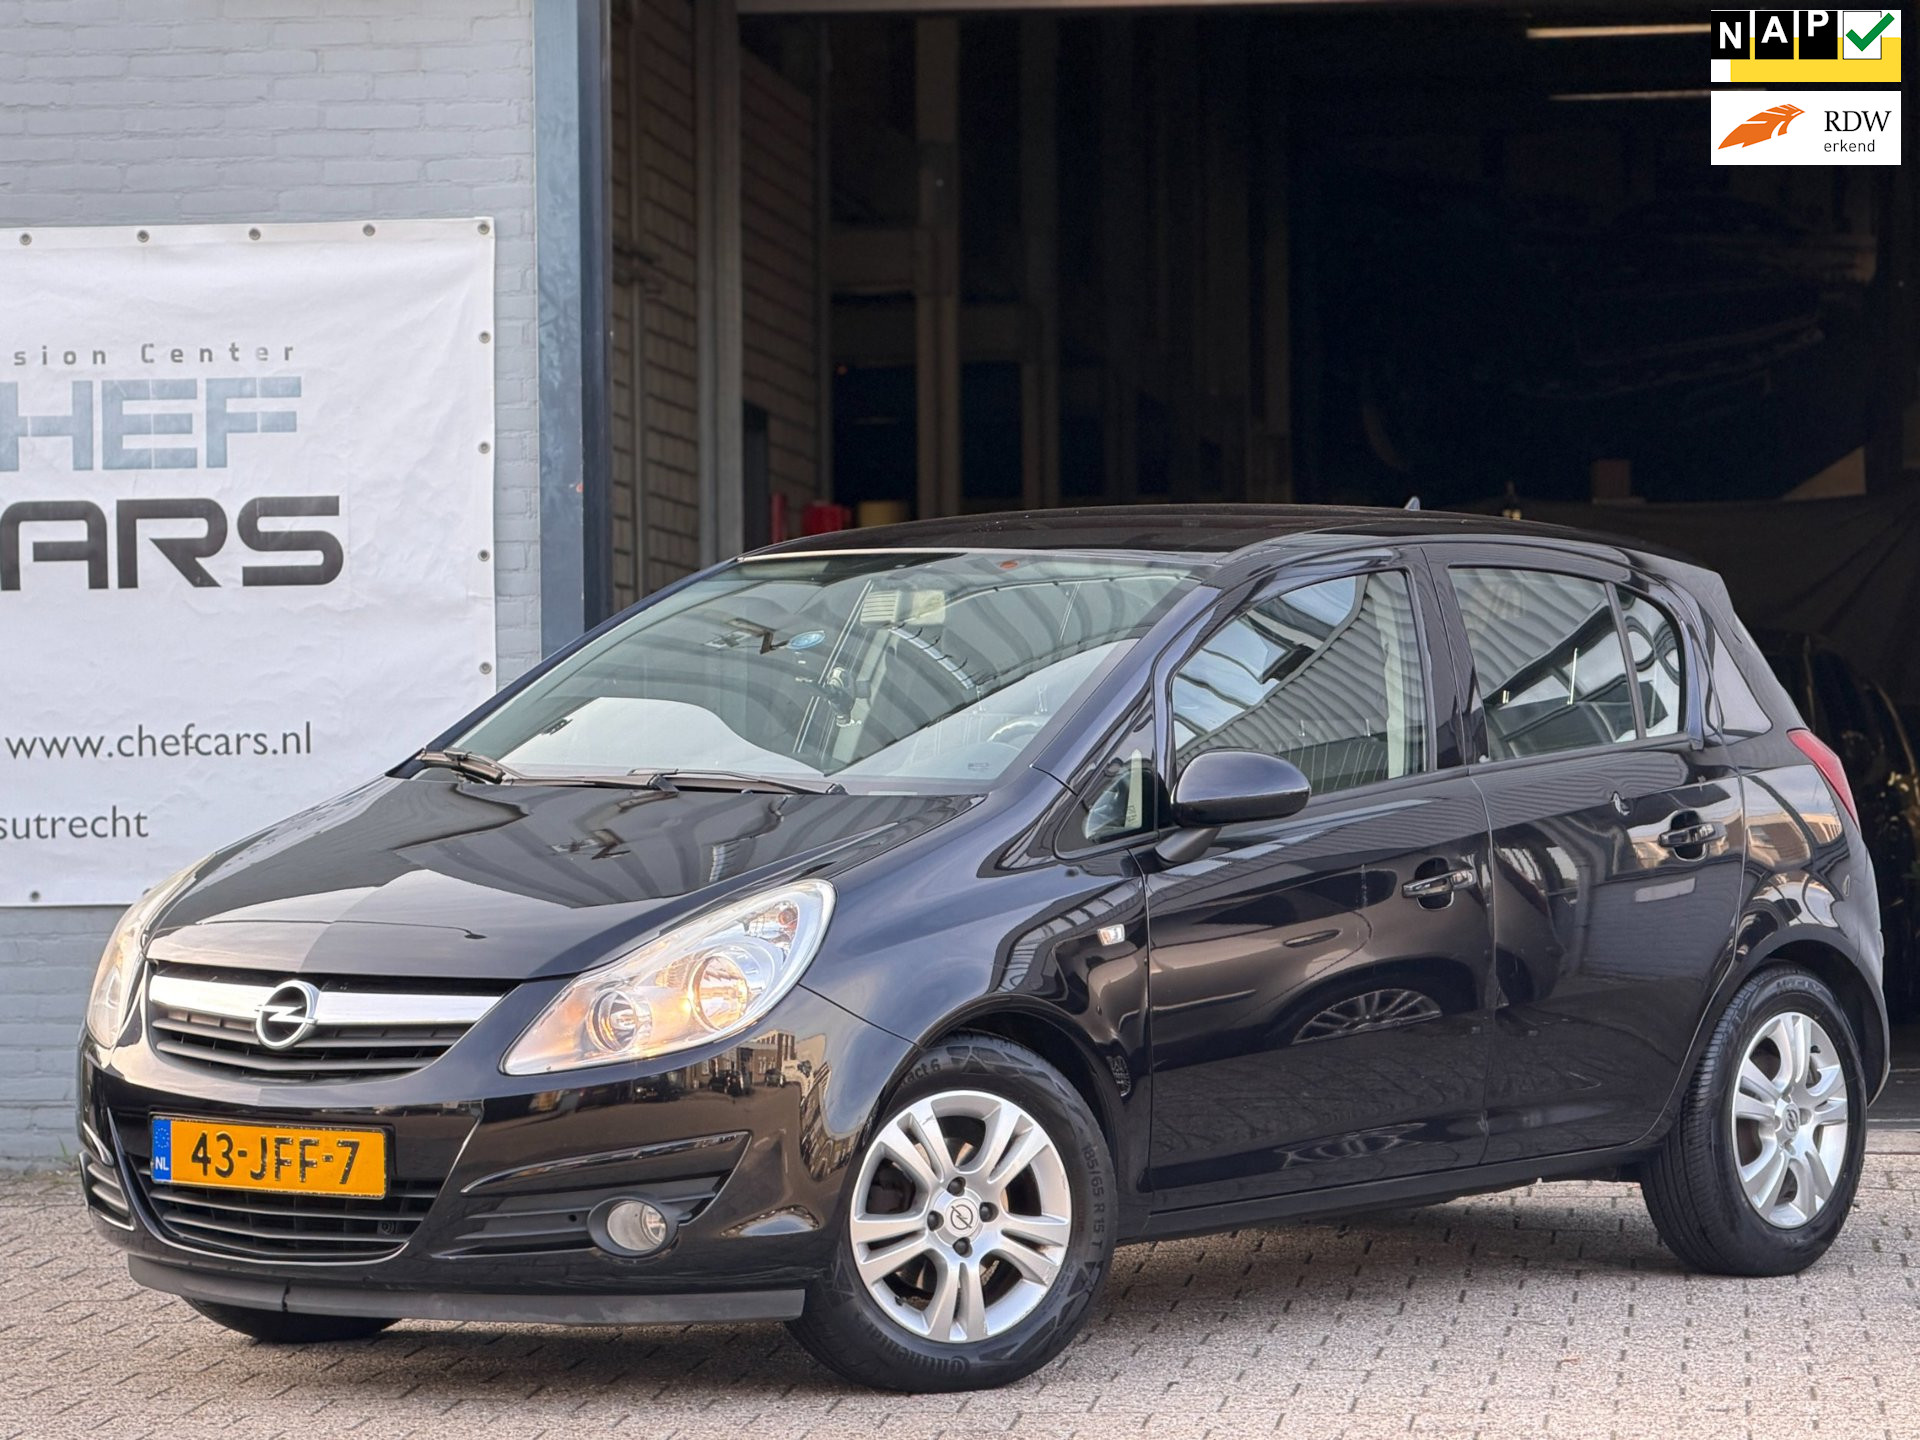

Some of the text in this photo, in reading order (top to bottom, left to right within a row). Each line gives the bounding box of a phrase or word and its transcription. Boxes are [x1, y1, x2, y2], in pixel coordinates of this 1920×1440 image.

[13, 342, 294, 366] sion Center
[0, 376, 302, 472] HEF
[0, 495, 344, 591] ARS
[5, 721, 312, 759] www.chefcars.nl
[0, 805, 149, 839] sutrecht
[154, 1156, 170, 1171] NL
[191, 1129, 360, 1185] 43-JFF-7
